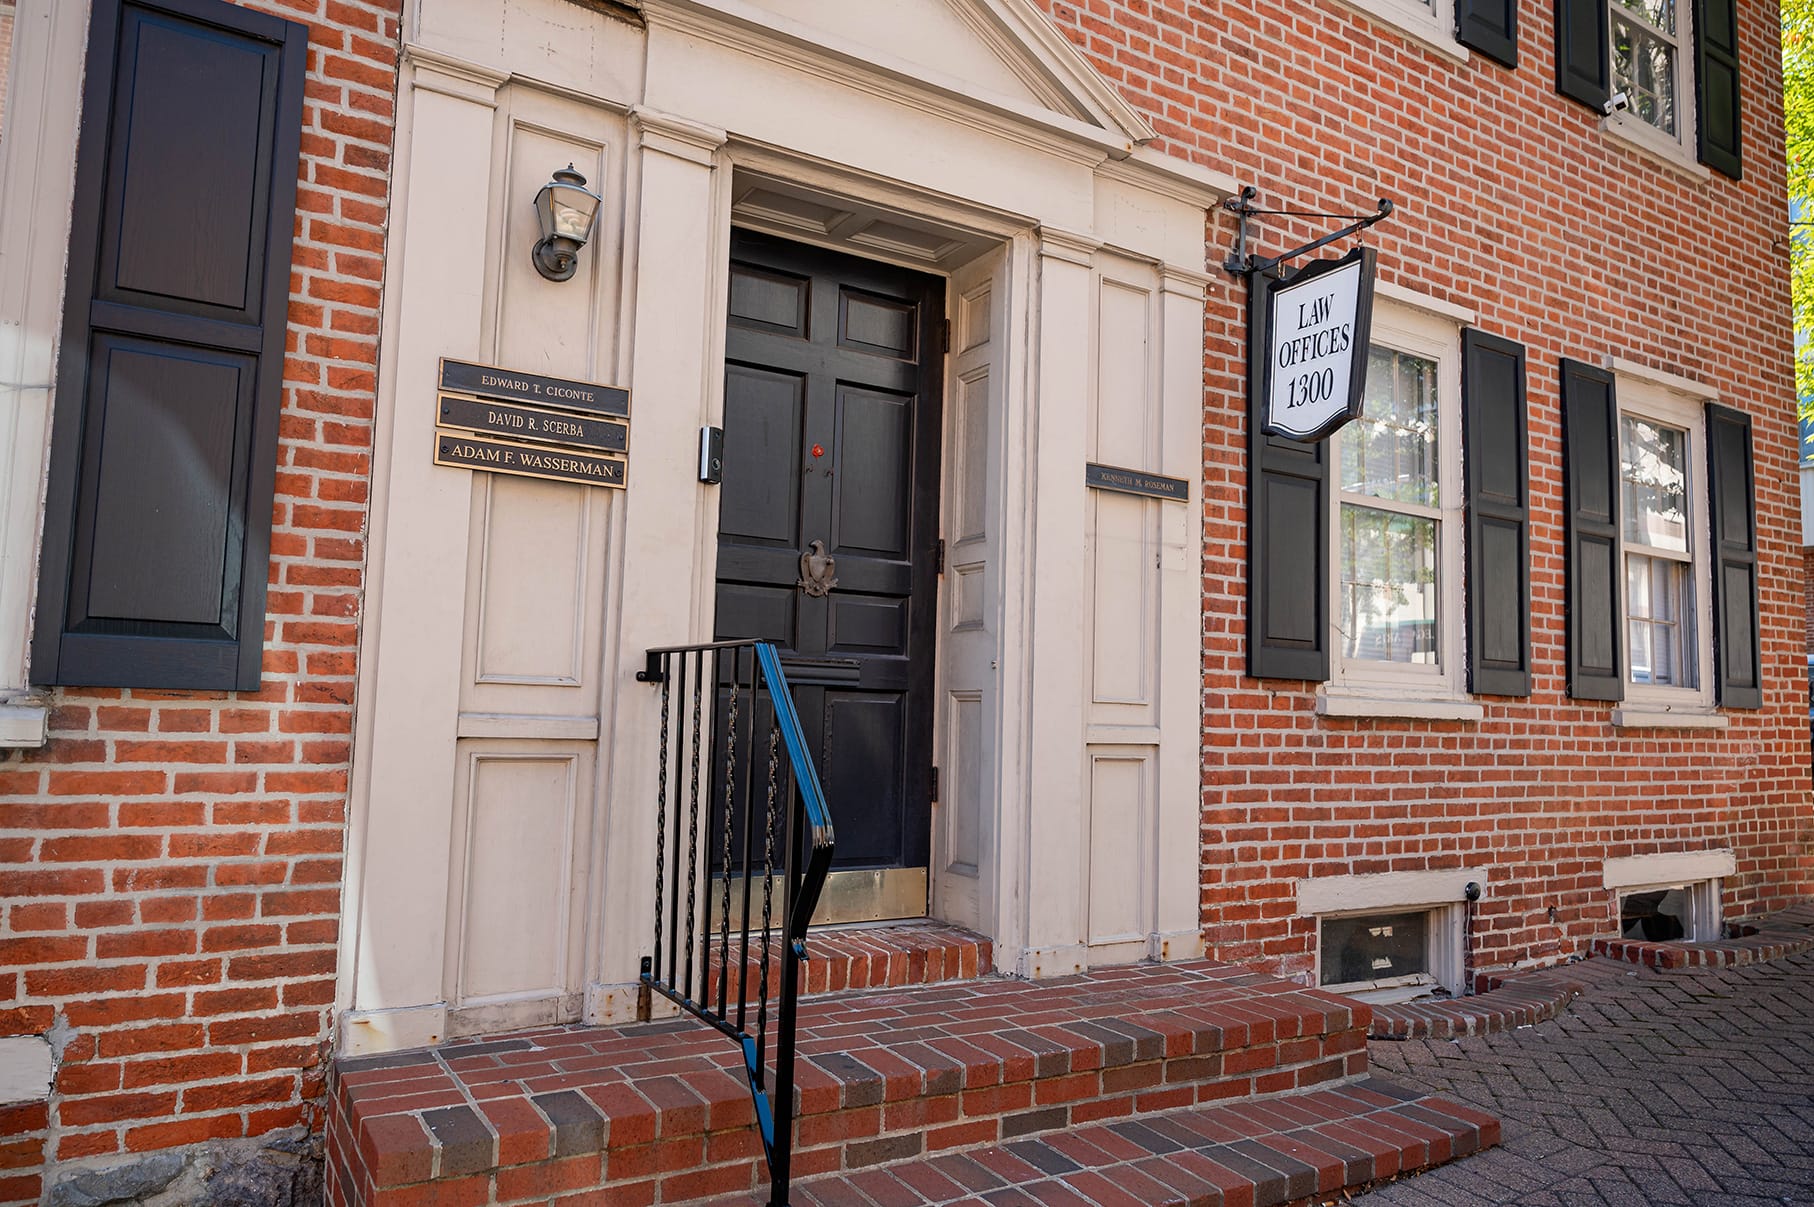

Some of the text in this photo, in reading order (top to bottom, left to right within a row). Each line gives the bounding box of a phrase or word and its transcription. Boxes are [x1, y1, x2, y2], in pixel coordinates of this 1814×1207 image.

[1298, 293, 1335, 330] LAW
[1279, 323, 1350, 369] OFFICES
[481, 375, 594, 402] EDWARD T. CICONTE
[1287, 367, 1334, 409] 1300
[488, 411, 584, 438] DAVID R. SCERBA
[451, 444, 614, 477] ADAM F. WASSERMAN
